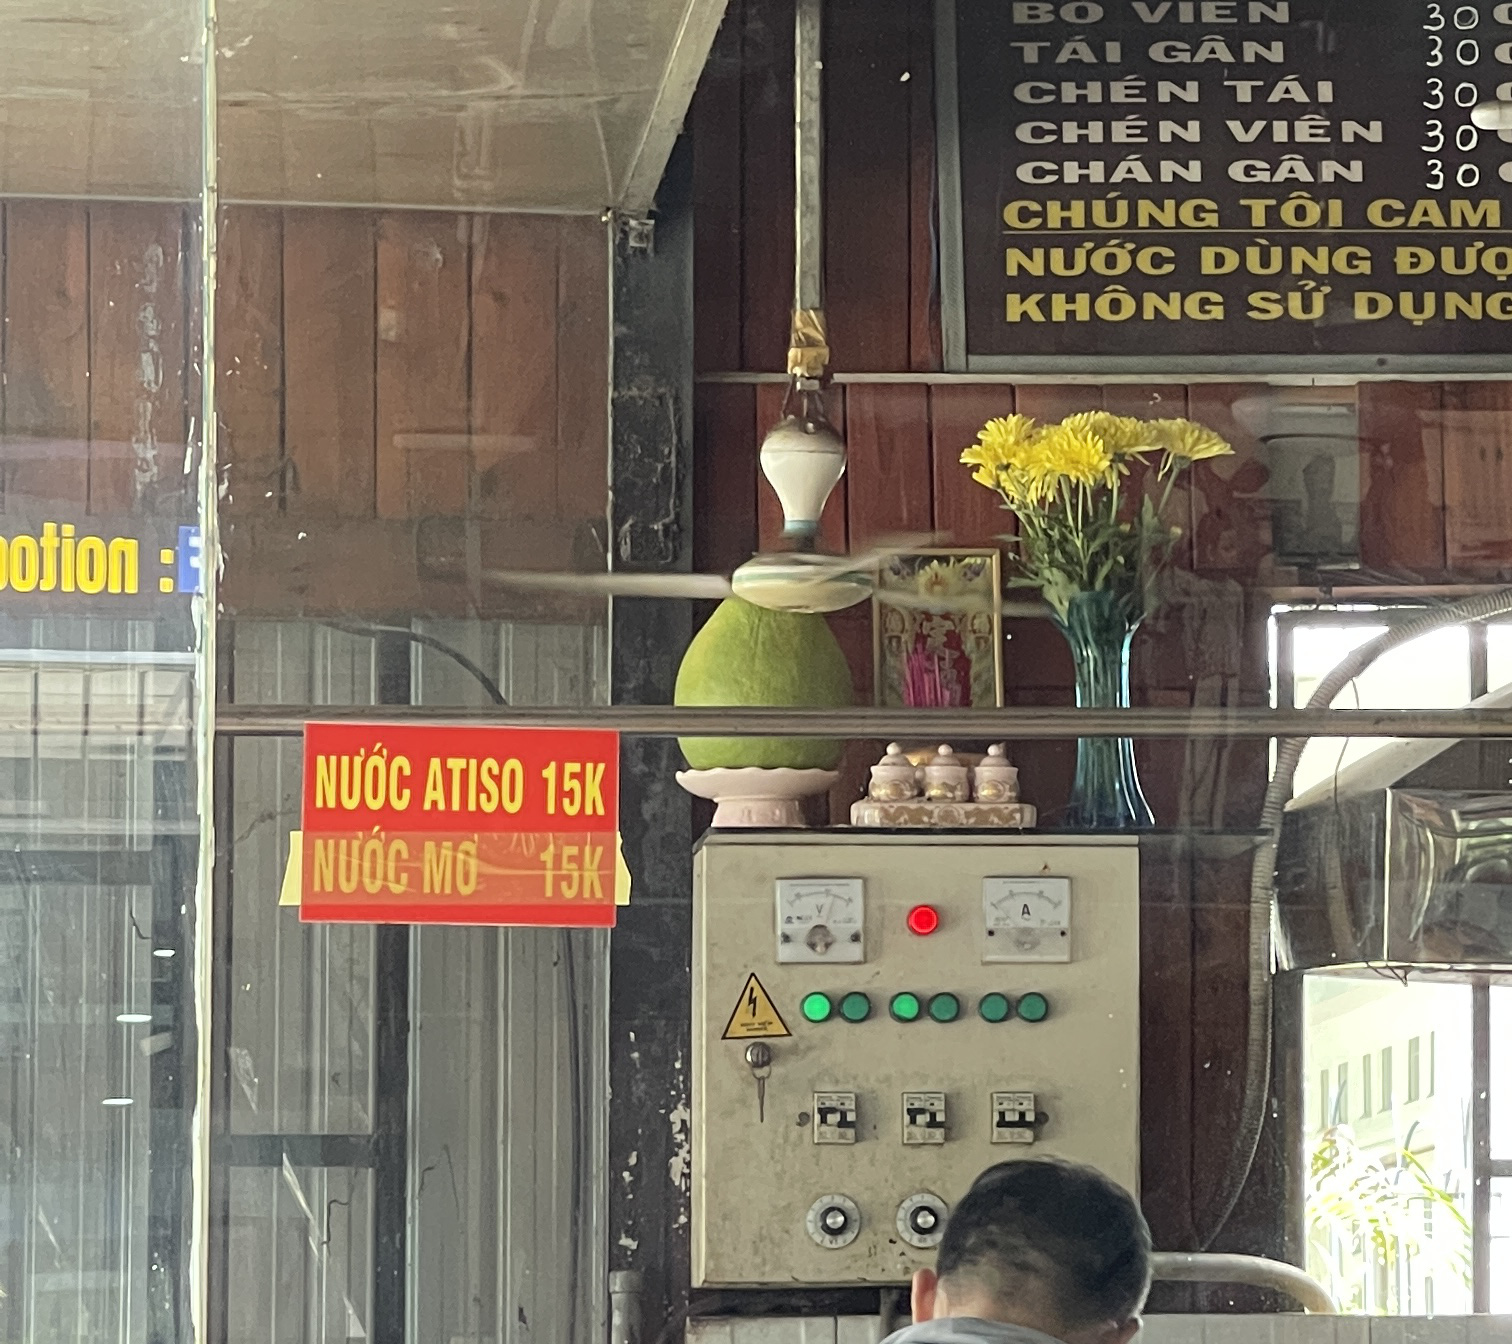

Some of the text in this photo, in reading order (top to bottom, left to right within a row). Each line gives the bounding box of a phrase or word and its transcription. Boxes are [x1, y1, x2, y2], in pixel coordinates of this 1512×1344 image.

[1423, 3, 1479, 31] 30
[1010, 35, 1121, 63] TÁI
[1149, 34, 1284, 63] GÂN
[1426, 35, 1479, 67] 30
[1013, 74, 1199, 104] CHÉN
[1224, 74, 1333, 103] TÁI
[1423, 78, 1478, 109] 30
[1015, 114, 1200, 144] CHÉN
[1225, 114, 1383, 143] VIÊN
[1420, 119, 1479, 152] 30
[1228, 153, 1363, 183] GÂN
[1426, 159, 1480, 190] 30
[1003, 191, 1219, 229] CHÚNG
[1240, 191, 1343, 228] TÔI
[1367, 198, 1500, 228] CAM
[1006, 240, 1176, 277] NƯỚC
[1201, 239, 1371, 275] DÙNG
[1006, 285, 1225, 322] KHÔNG
[1246, 279, 1332, 321] SỬ
[315, 743, 606, 816] NƯỚC ATISO 15K
[313, 826, 409, 894] NƯỚC
[540, 844, 604, 899] 15K
